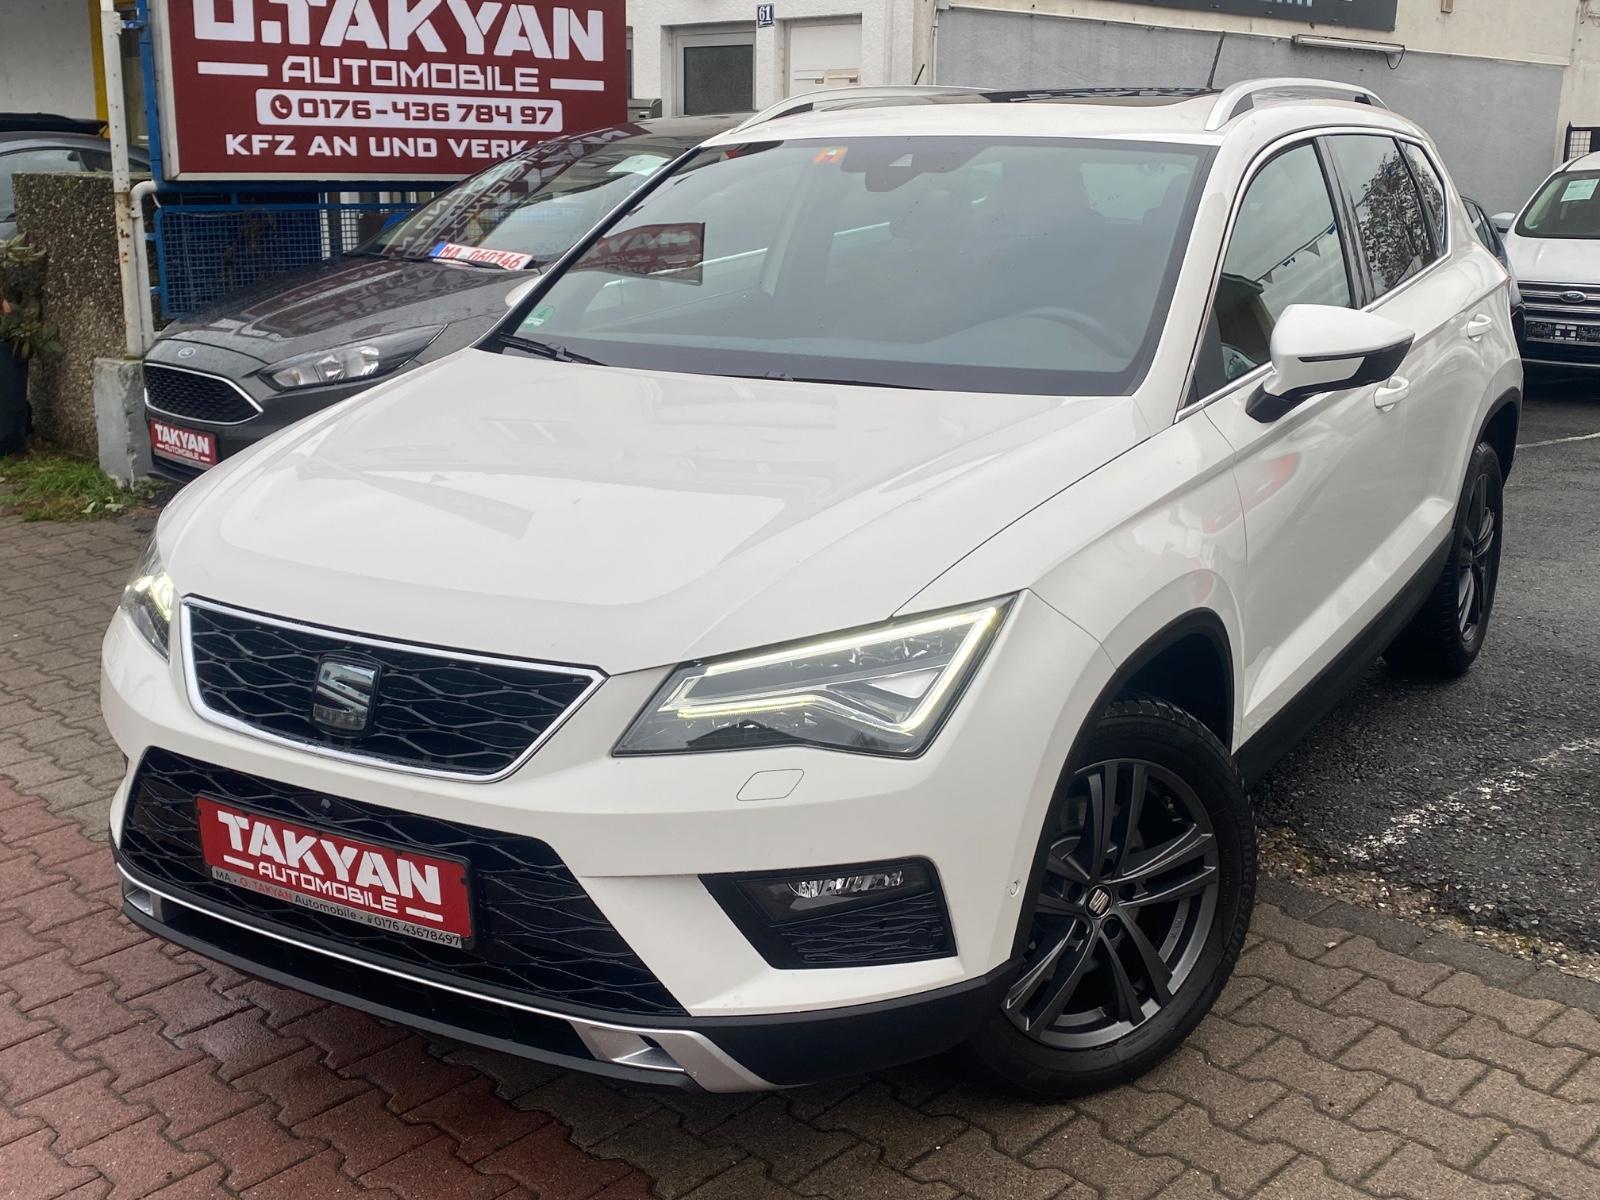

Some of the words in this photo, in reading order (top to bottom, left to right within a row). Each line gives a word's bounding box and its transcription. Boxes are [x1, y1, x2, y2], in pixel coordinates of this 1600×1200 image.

[759, 5, 772, 21] 61
[282, 55, 540, 93] AUTOMOBILE
[297, 98, 450, 122] 0176-436
[456, 103, 513, 124] 784
[519, 106, 554, 125] 97
[225, 133, 297, 156] KFZ
[307, 135, 358, 157] AN
[368, 136, 438, 158] UND
[446, 138, 546, 160] VERK
[154, 423, 210, 455] TAKYAN
[217, 810, 442, 906] TAKYAN
[258, 861, 399, 914] AUTOMOBILE
[215, 869, 232, 882] MA
[295, 894, 358, 921] Automobile
[374, 916, 400, 932] 0176
[402, 923, 460, 947] 43678497
